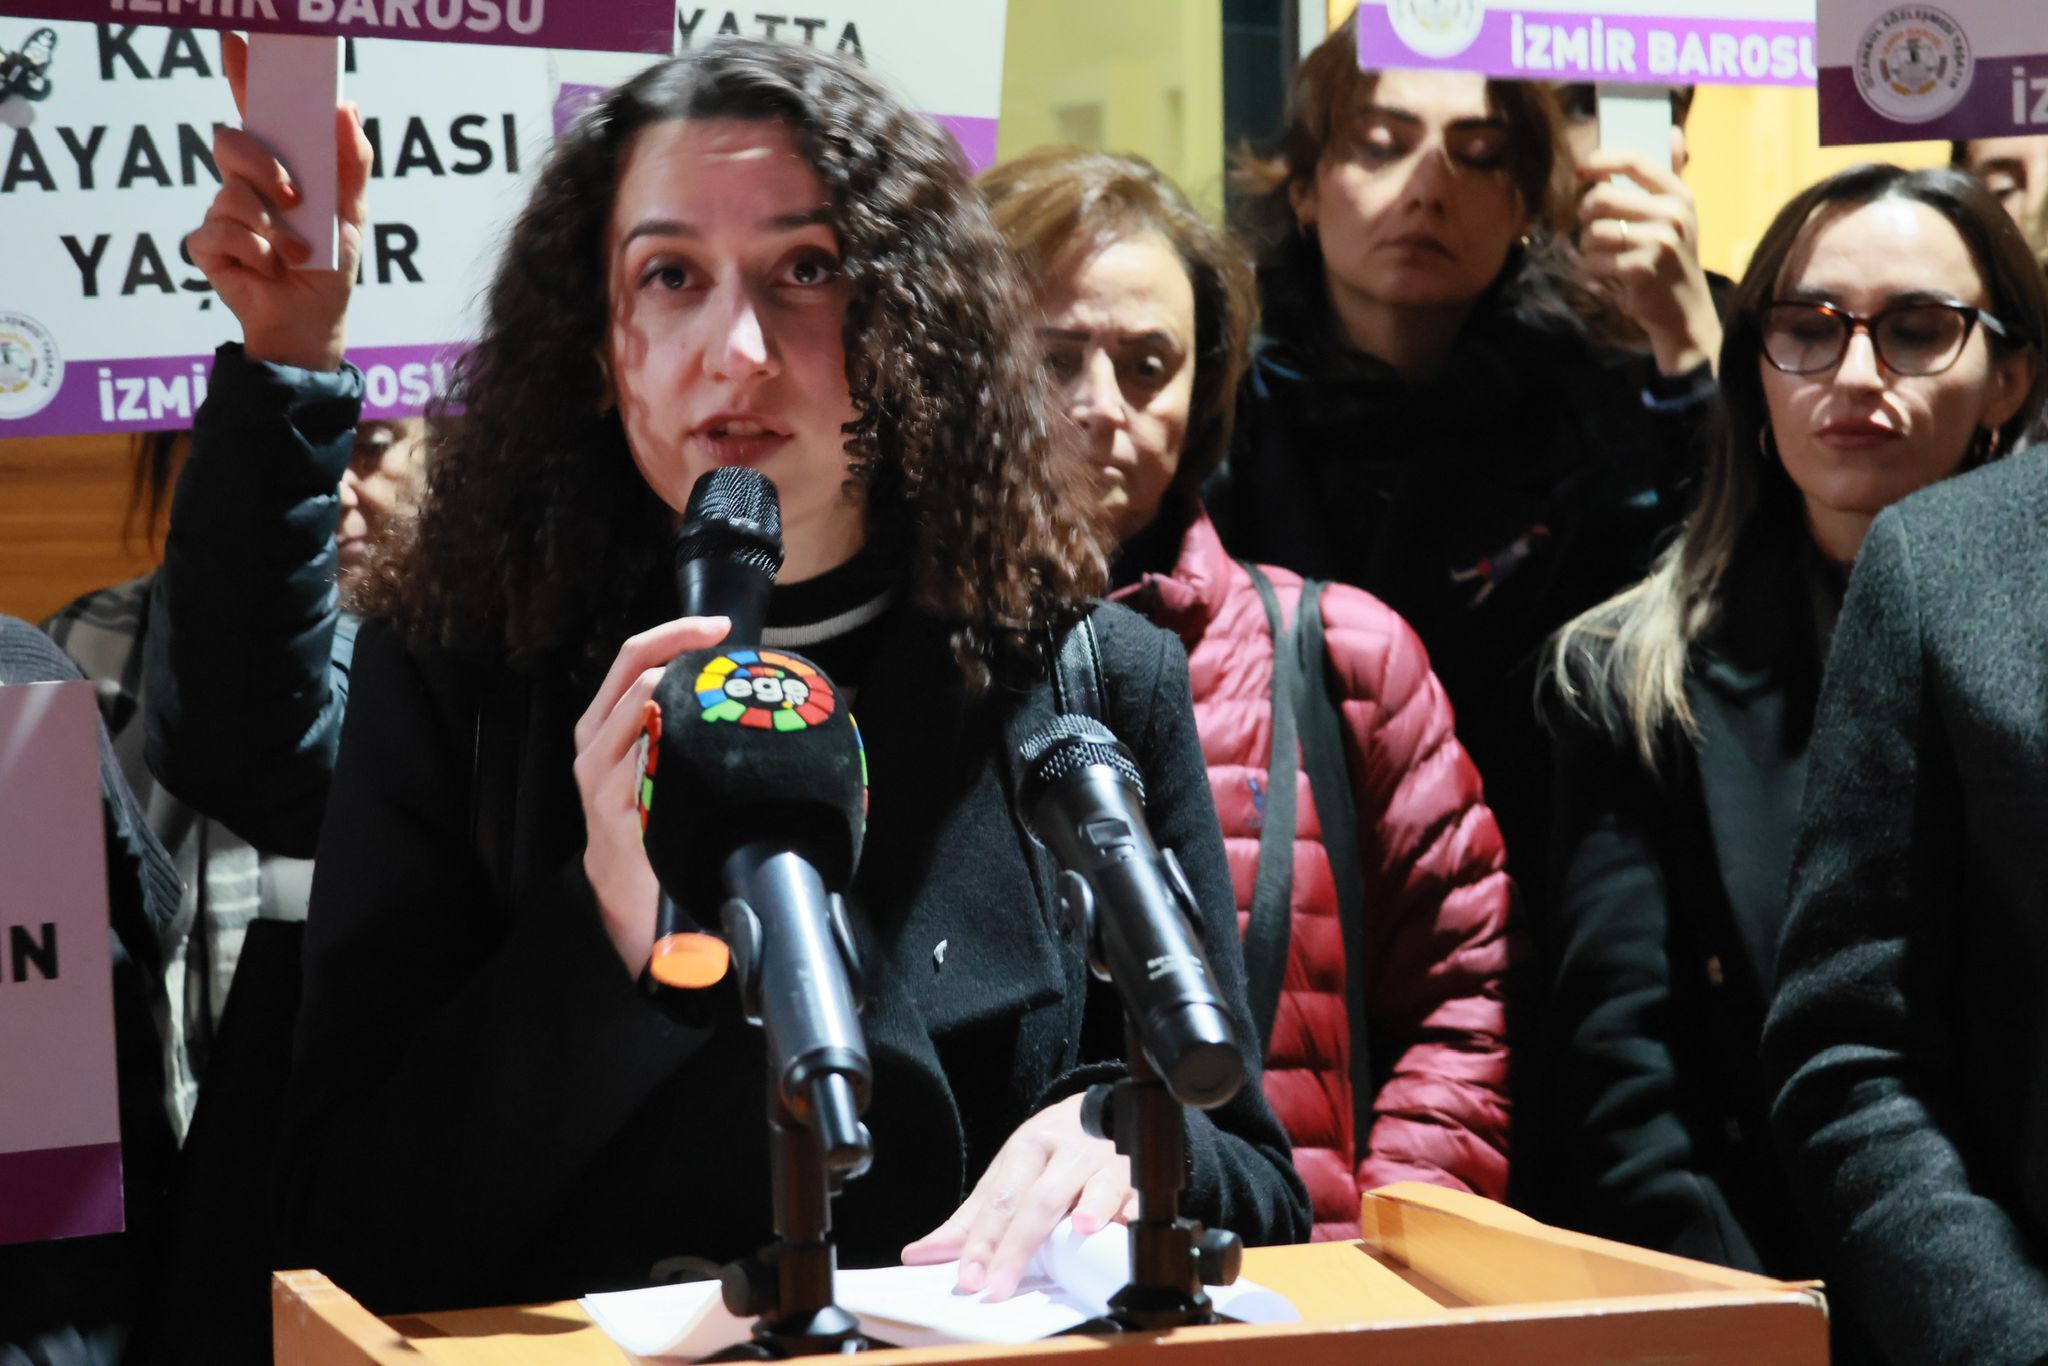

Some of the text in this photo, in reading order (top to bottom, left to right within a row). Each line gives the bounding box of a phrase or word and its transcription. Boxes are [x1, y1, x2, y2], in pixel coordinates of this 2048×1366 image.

[1511, 13, 1637, 74] İZMİR
[98, 363, 208, 421] İZMİ
[0, 922, 59, 983] N
